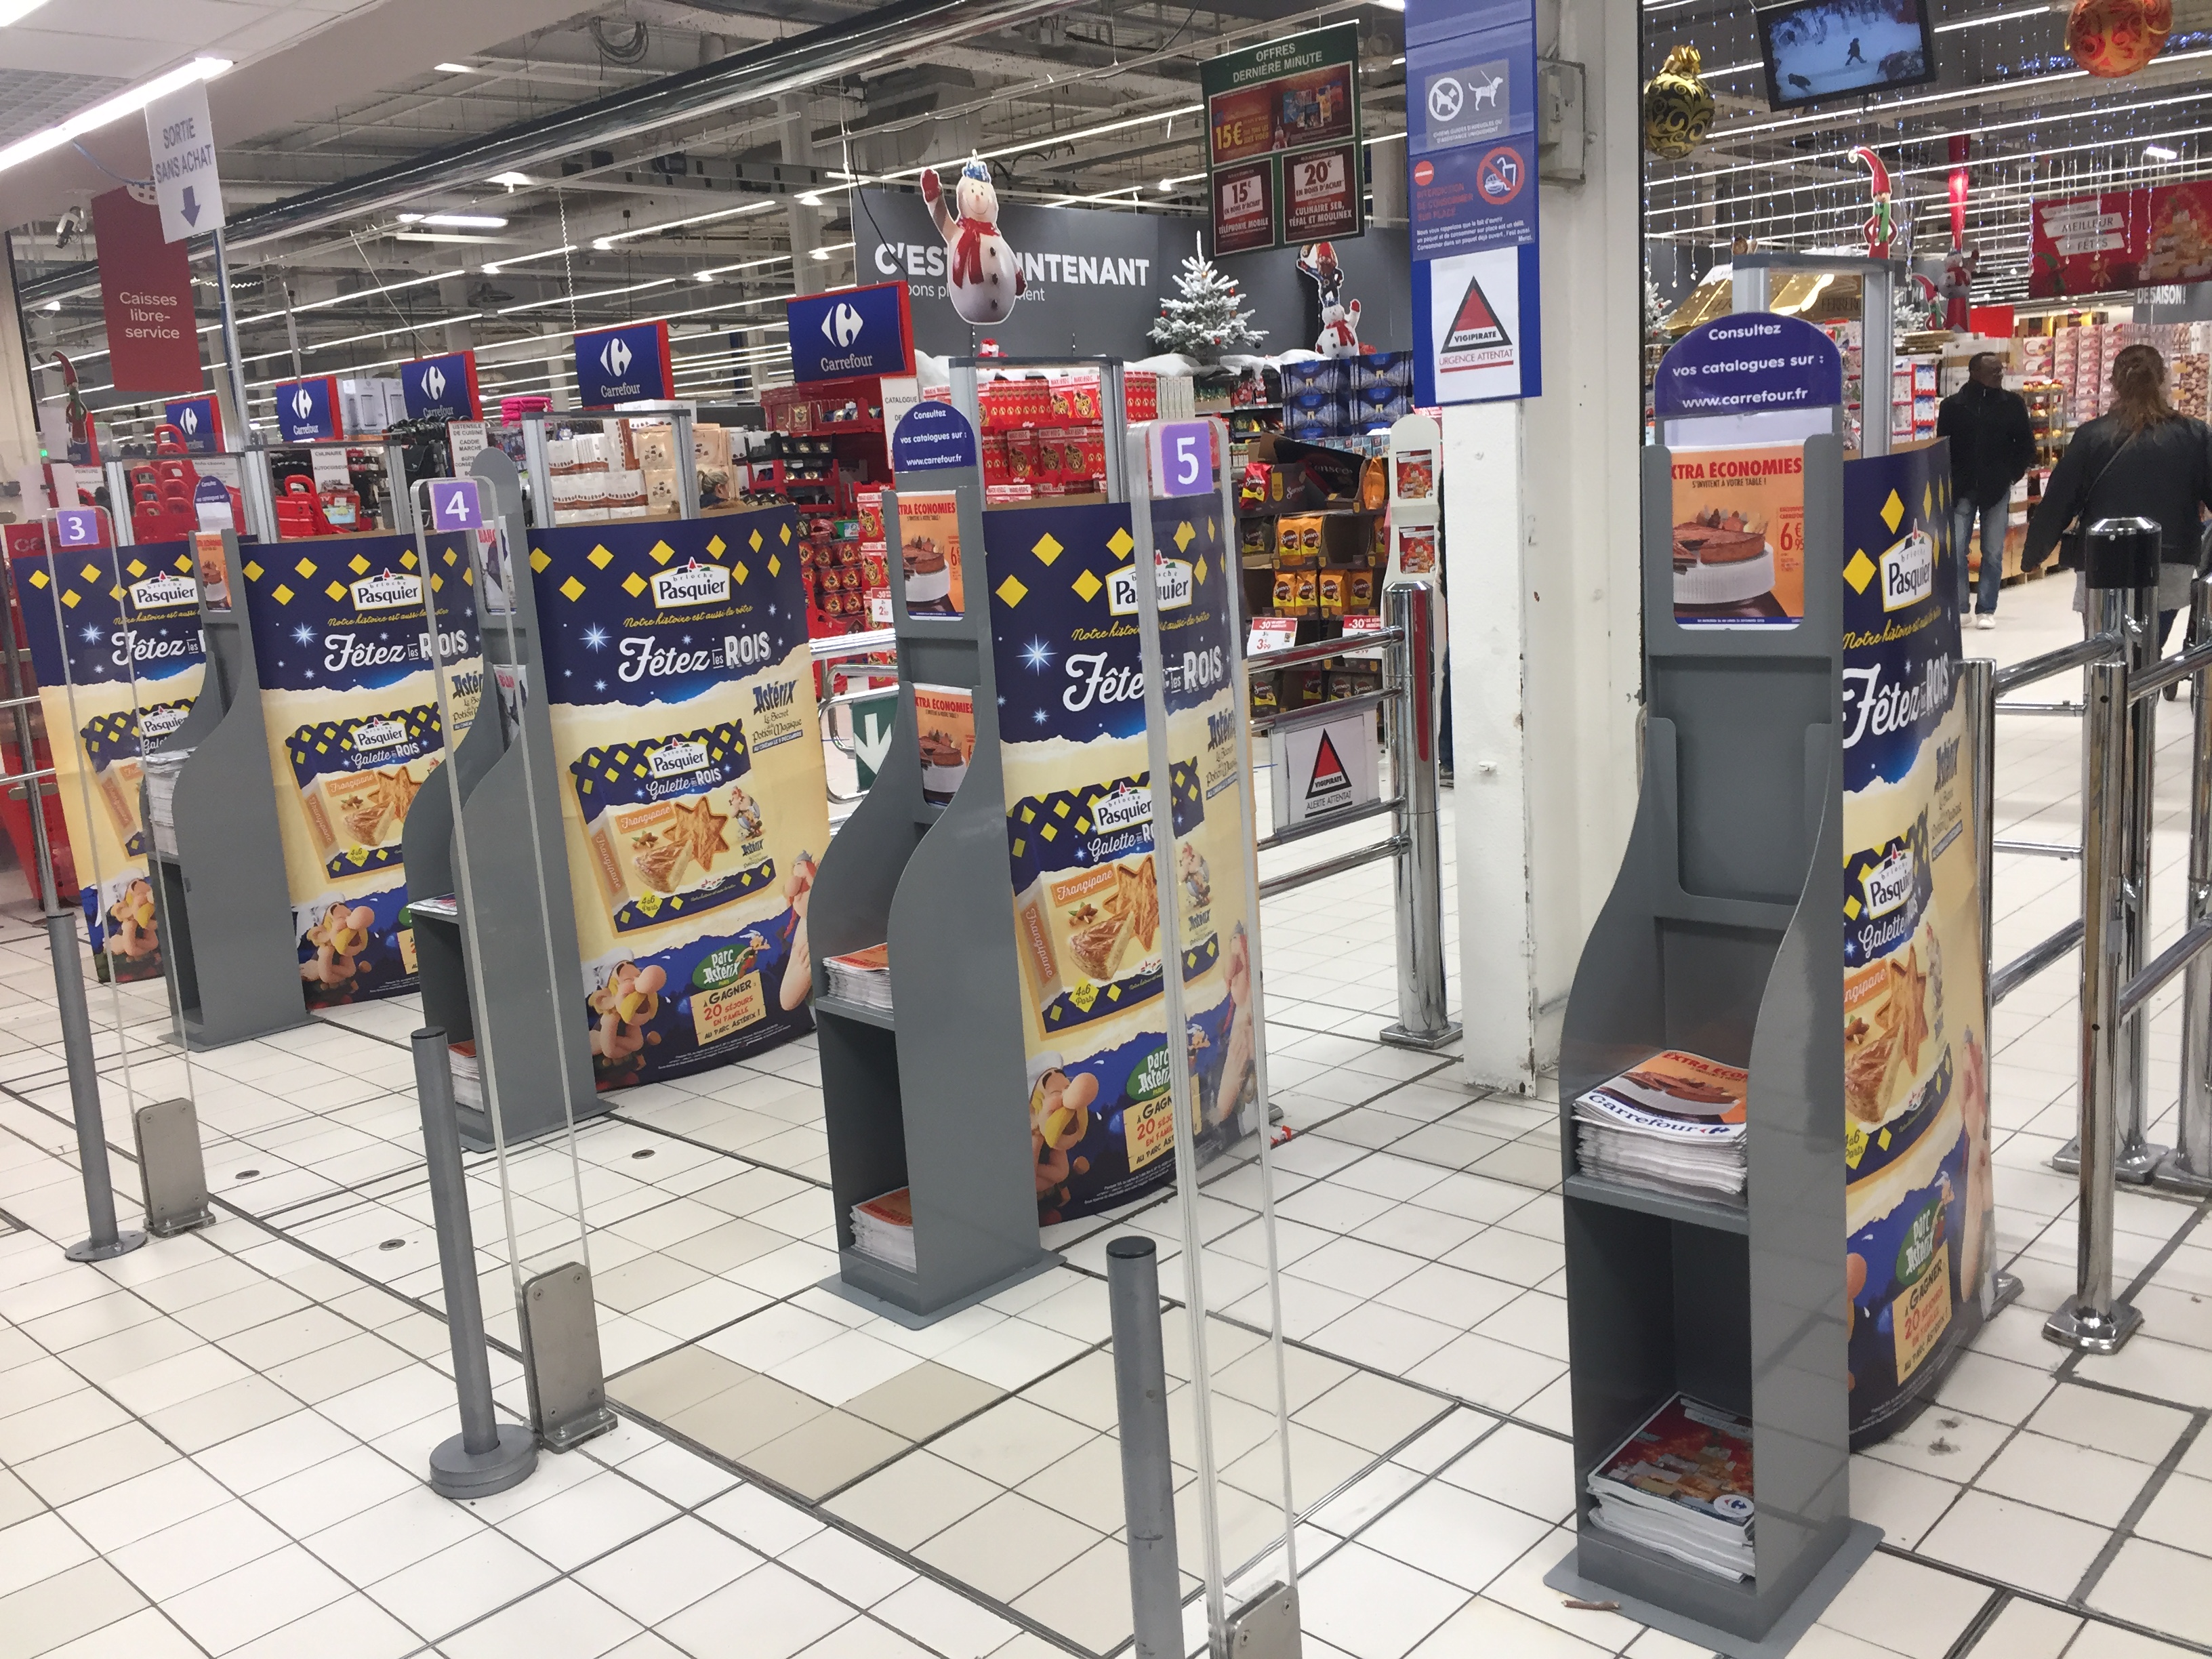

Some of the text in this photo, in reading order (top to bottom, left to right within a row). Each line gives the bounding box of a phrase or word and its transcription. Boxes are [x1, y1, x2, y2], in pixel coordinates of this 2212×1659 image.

[1256, 43, 1296, 62] OFFRES
[1233, 51, 1322, 83] DERNIÈRE MINUTE
[163, 117, 195, 148] SORTIE
[1216, 121, 1243, 149] 15€
[156, 144, 211, 184] SANS ACHAT
[1304, 186, 1318, 194] BONS
[1289, 209, 1352, 228] TÉFAL ET MOULINEX
[1295, 203, 1328, 216] CULINAIRE
[1218, 218, 1269, 234] TÉLÉPHONIE MOBILE
[874, 243, 947, 276] C'ES
[120, 292, 177, 306] Caisses
[2137, 287, 2149, 304] DE
[130, 308, 171, 323] libre-
[125, 326, 180, 339] service
[1454, 331, 1496, 343] VIGIPIRATE
[1708, 323, 1781, 341] Consultez
[820, 354, 873, 372] Carrefour
[1439, 348, 1514, 366] URGENCE ATTENTAT
[1673, 355, 1815, 376] vos catalogues sur
[600, 382, 641, 398] Carrefour
[1682, 388, 1808, 409] www.carrefour.fr
[423, 405, 454, 418] Carrefour
[913, 409, 947, 420] Consultez
[293, 424, 319, 435] Carrefour
[913, 433, 950, 443] catalogues
[906, 454, 962, 466] www.carrefour.fr
[1176, 436, 1199, 485] 5
[1671, 457, 1803, 480] XTRA ÉCONOMIES
[1692, 477, 1762, 489] S'INVITENT VOTRE TABLE
[445, 491, 470, 523] 4
[914, 502, 956, 515] ÉCONOMIES
[68, 516, 86, 541] 3
[369, 581, 407, 589] brioche
[673, 572, 714, 582] brioche
[1889, 560, 1931, 597] Pasquier
[136, 588, 194, 603] Pasquier
[357, 586, 419, 605] Pasquier
[659, 579, 726, 601] Pasquier
[135, 613, 165, 623] histoire
[178, 610, 197, 618] aussi
[327, 611, 419, 628] Notre histoire est aussi
[623, 603, 754, 628] Notre histoire est aussi la vôtre
[1071, 626, 1108, 640] Notre
[1843, 630, 1882, 650] Notre
[111, 630, 198, 666] Fêtez les
[324, 630, 470, 672] Fêtez les ROIS
[618, 631, 772, 683] Fêtez les ROIS
[1183, 645, 1223, 693] ROIS
[752, 680, 796, 716] Astérix
[933, 698, 973, 714] ÉCONOMIES
[1843, 652, 1950, 749] Fêtez ROIS
[357, 728, 403, 747] Pasquier
[350, 742, 421, 769] Galette ROIS
[654, 751, 704, 773] Pasquier
[329, 775, 373, 793] Frangipane
[646, 767, 722, 800] Galette ROIS
[1314, 774, 1343, 788] VIGIPIRATE
[1306, 790, 1351, 811] ALERTE ATTENTAT
[620, 805, 672, 829] Frangipane
[1098, 800, 1152, 826] Pasquier
[741, 838, 764, 857] Astérix
[1088, 832, 1136, 862] Galette
[596, 835, 621, 890] Frangipane
[1057, 869, 1113, 901] Frangipane
[1025, 907, 1052, 978] Frangipane
[712, 949, 734, 967] Parc
[703, 962, 740, 984] Astérix
[709, 979, 752, 1004] GAGNER
[703, 995, 754, 1021] 20 SÉJOURS
[723, 1006, 748, 1022] FAMILLE
[714, 1024, 729, 1035] PARC
[731, 1013, 756, 1027] ASTÉRIX
[1662, 1052, 1710, 1071] EXTRA
[1588, 1094, 1699, 1133] Carrefour
[1137, 1118, 1155, 1141] 20
[1145, 1137, 1155, 1147] EN
[1136, 1144, 1162, 1164] AU PARC
[1913, 1209, 1930, 1240] Parc
[1909, 1259, 1942, 1310] GAGNER
[1905, 1309, 1919, 1340] 20
